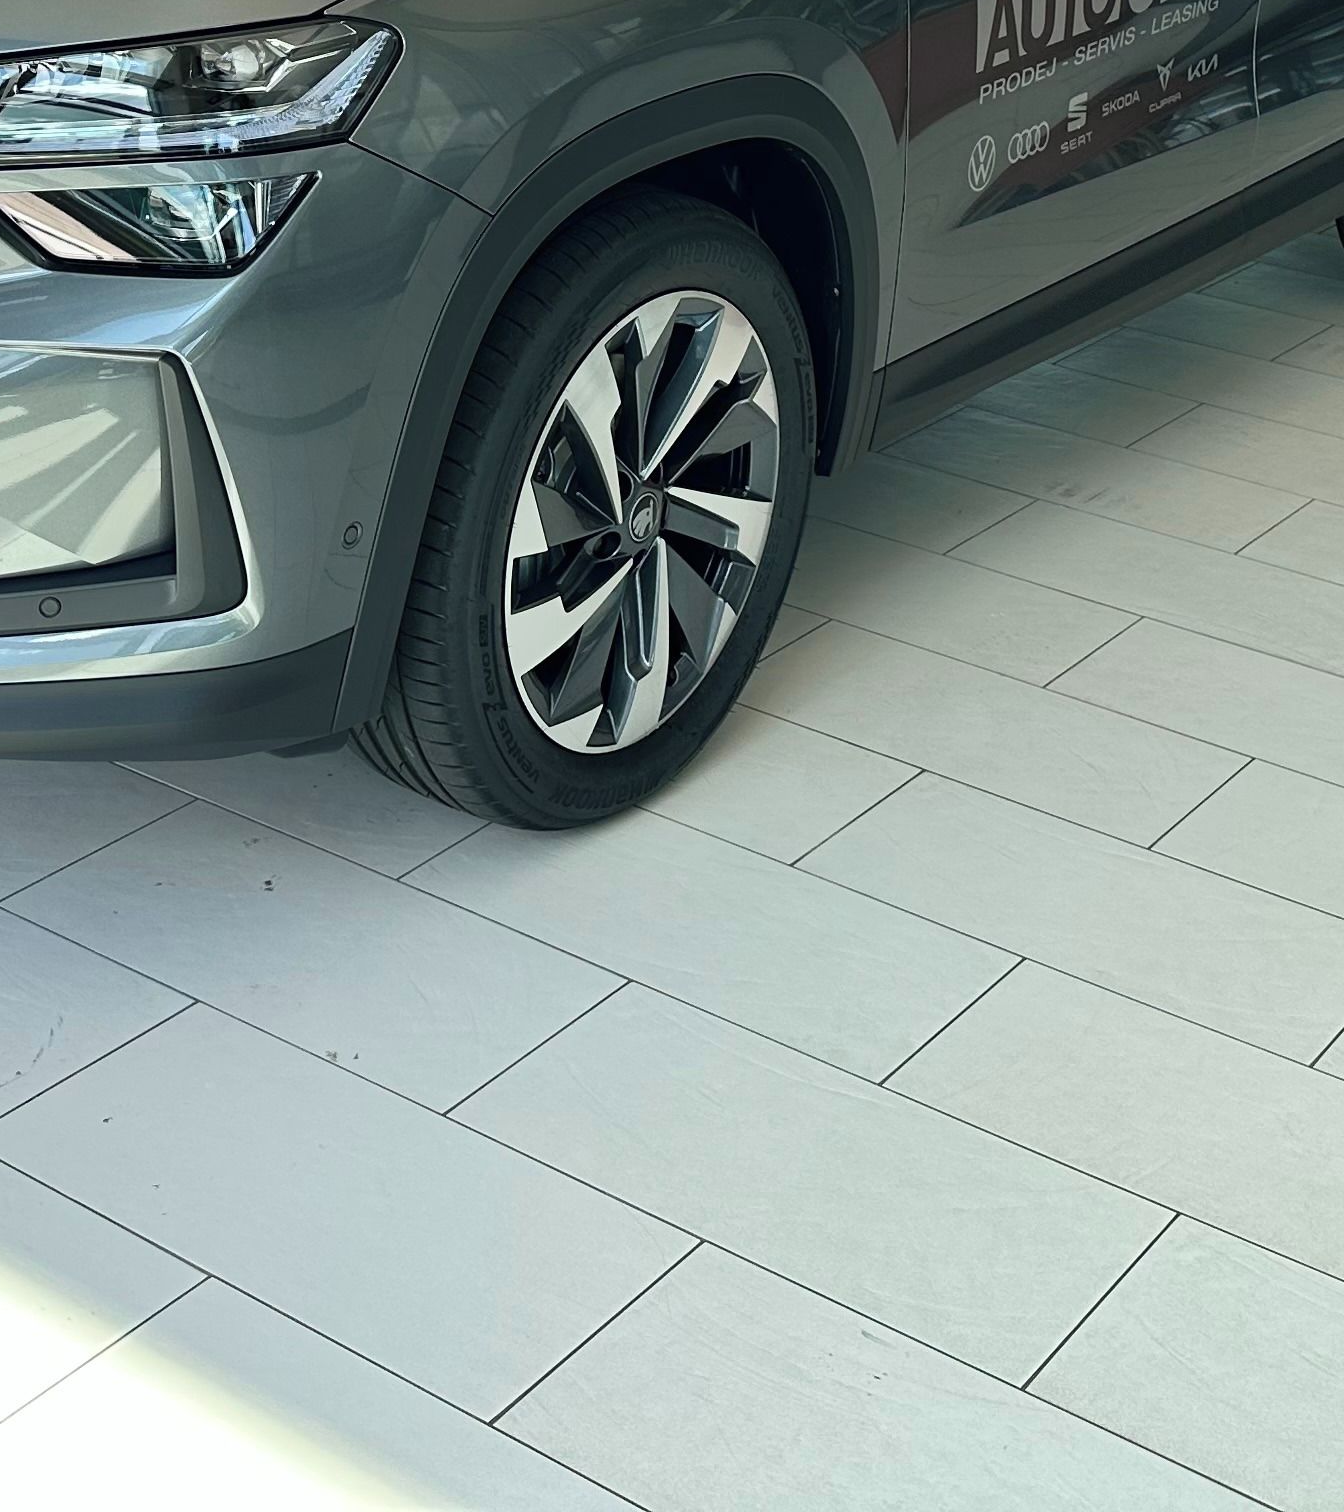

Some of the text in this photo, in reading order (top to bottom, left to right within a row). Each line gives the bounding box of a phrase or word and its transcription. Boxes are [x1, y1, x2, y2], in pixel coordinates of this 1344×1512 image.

[979, 57, 1057, 105] PRODEJ
[1073, 26, 1136, 66] SERVIS
[1148, 91, 1182, 114] CUPRA
